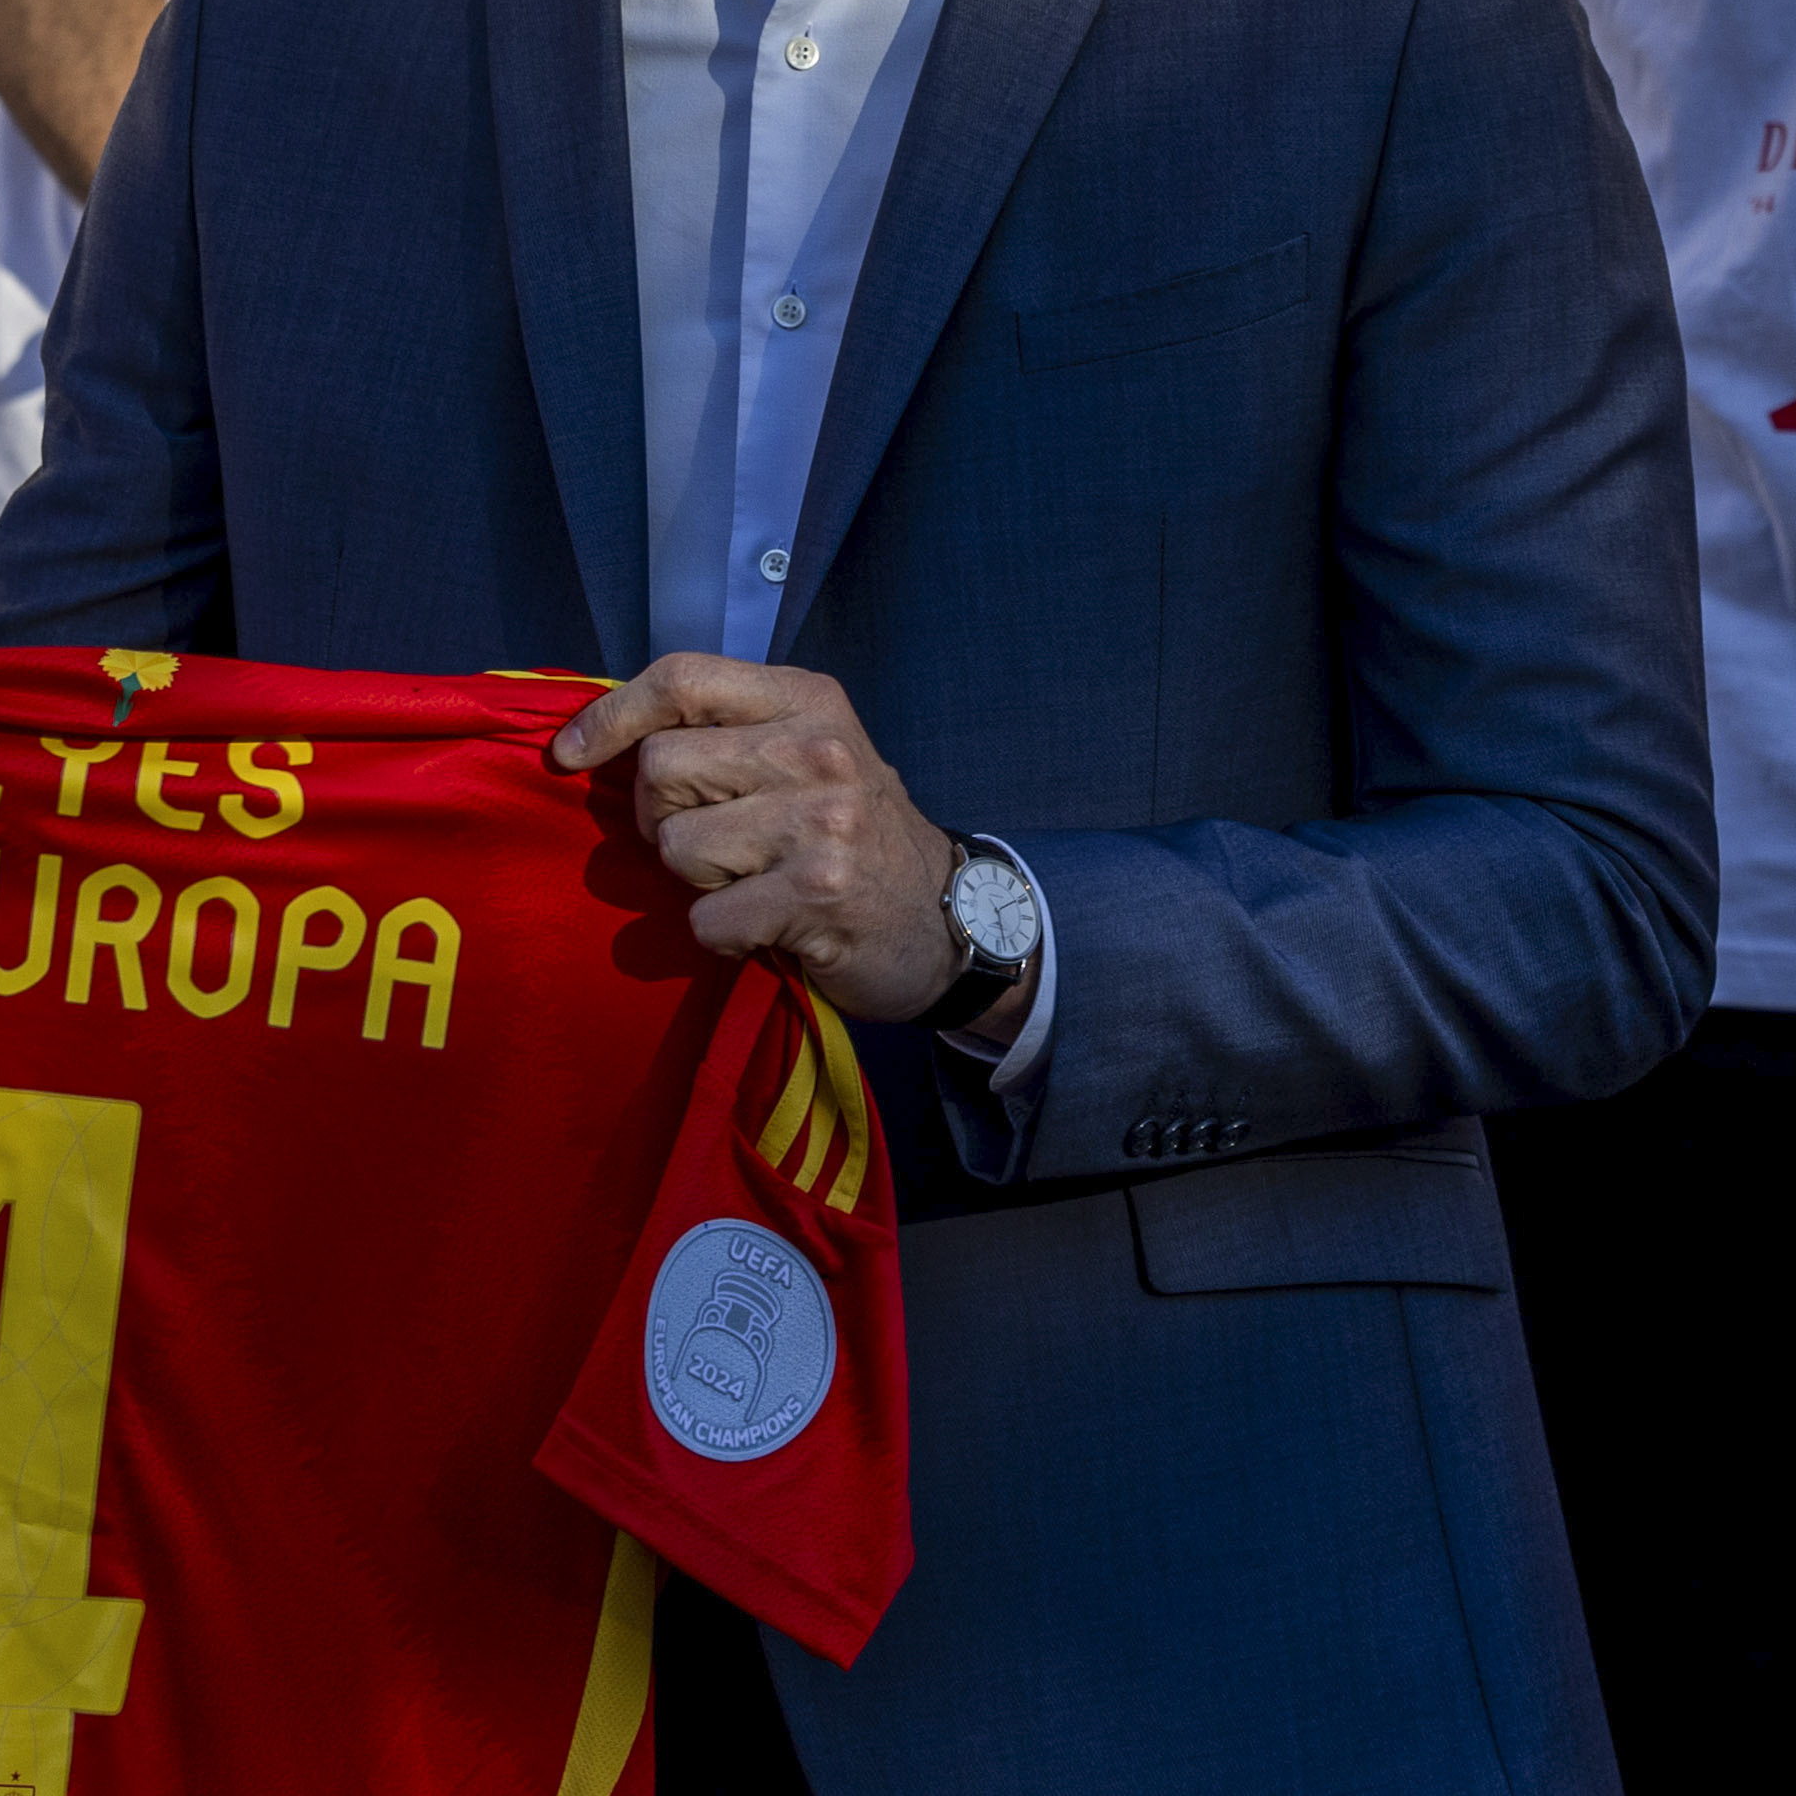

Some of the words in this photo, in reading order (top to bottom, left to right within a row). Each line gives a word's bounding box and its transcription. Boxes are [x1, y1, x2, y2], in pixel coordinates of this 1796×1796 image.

[729, 1236, 793, 1290] UEFA
[653, 1318, 696, 1432] EUROPEAN
[694, 1395, 803, 1448] CHAMPIONS
[686, 1354, 746, 1402] 2024
